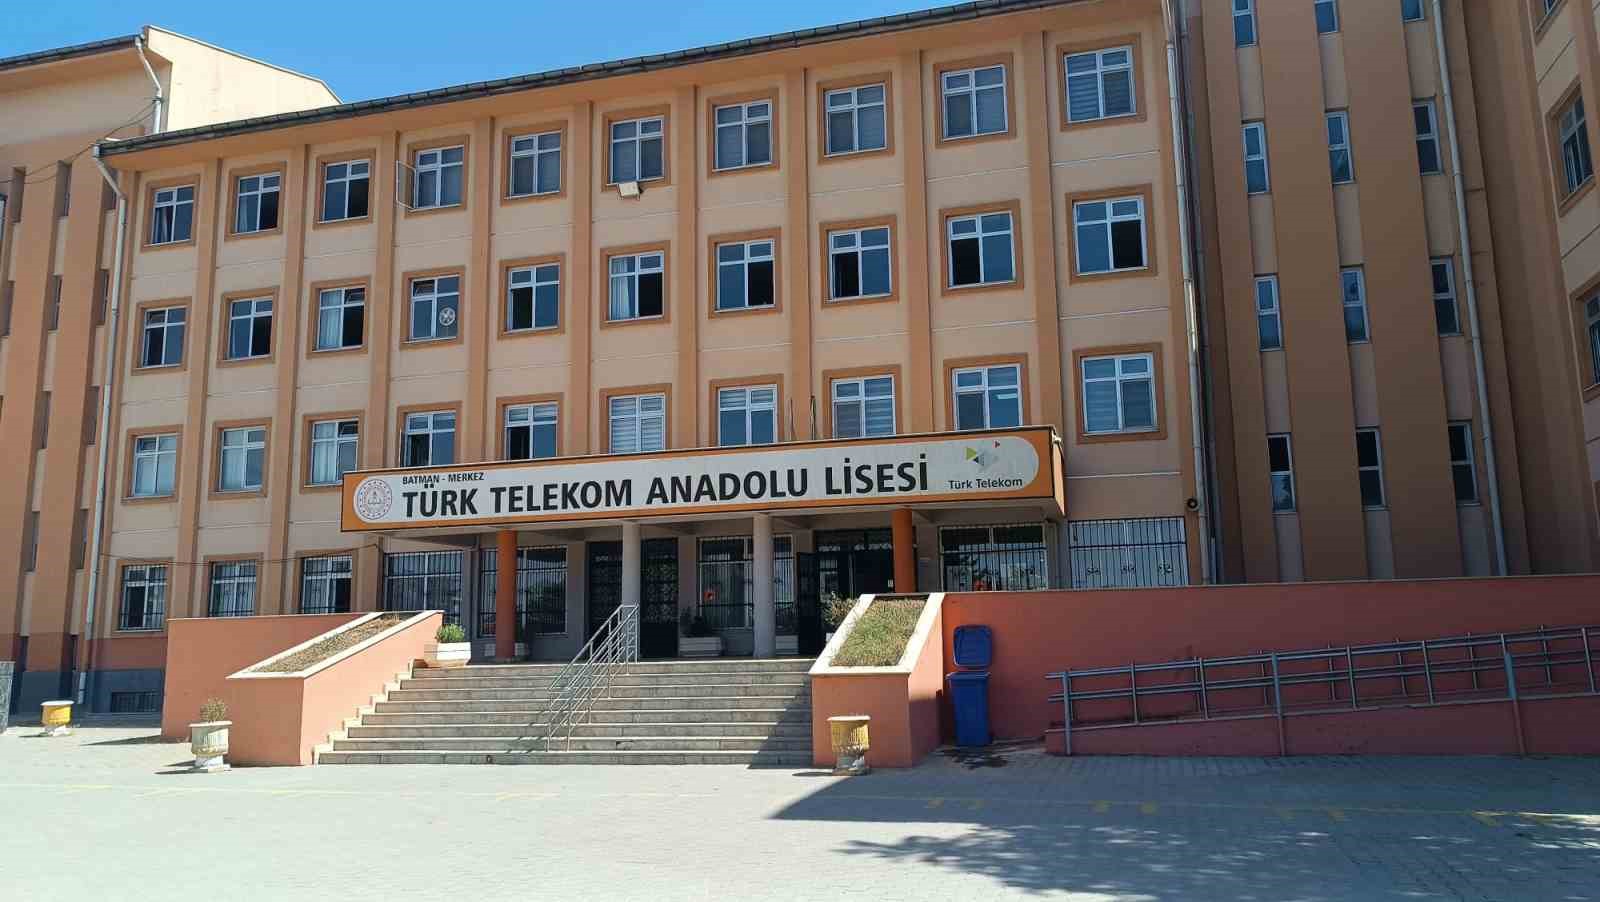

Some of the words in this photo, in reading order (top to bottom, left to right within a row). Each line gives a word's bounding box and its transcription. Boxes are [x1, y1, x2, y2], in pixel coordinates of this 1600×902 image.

[402, 475, 440, 485] BATMAN
[448, 472, 484, 483] MERKEZ
[402, 483, 478, 517] TÜRK
[490, 479, 632, 514] TELEKOM
[646, 468, 808, 505] ANADOLU
[825, 453, 928, 495] LİSESİ
[948, 480, 973, 490] Türk
[975, 478, 1023, 488] Telekom
